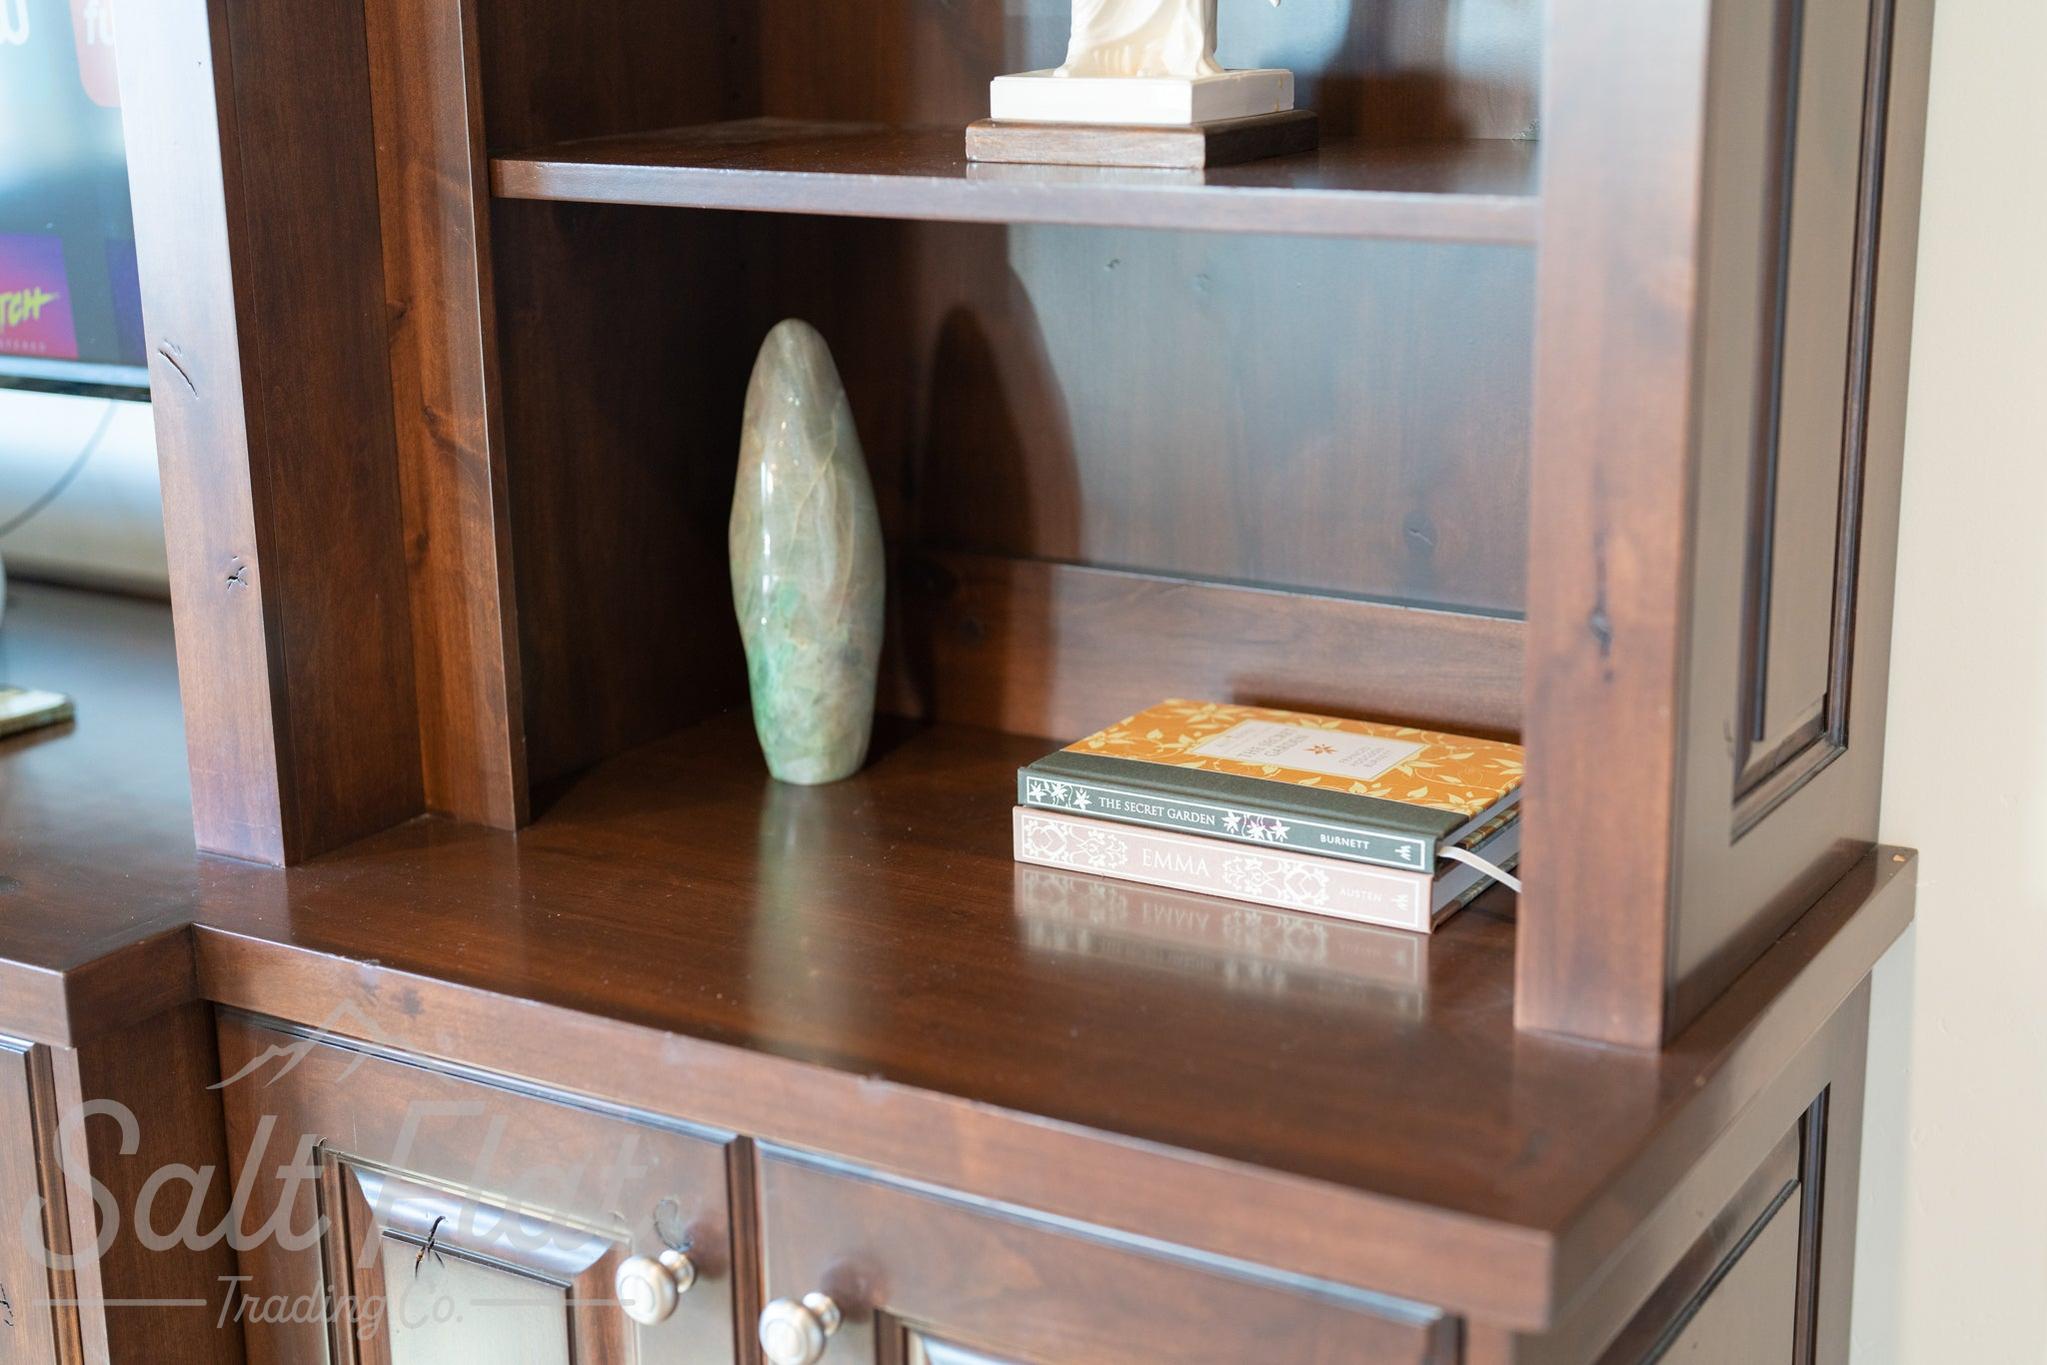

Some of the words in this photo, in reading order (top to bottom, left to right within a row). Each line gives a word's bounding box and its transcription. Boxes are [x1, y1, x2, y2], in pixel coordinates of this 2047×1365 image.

[1098, 796, 1122, 810] THE
[1124, 801, 1165, 817] SECRET
[1167, 807, 1216, 825] GARDEN
[1320, 833, 1370, 850] BURNETT
[1142, 848, 1210, 877] EMMA
[1339, 886, 1384, 903] AUSTEN
